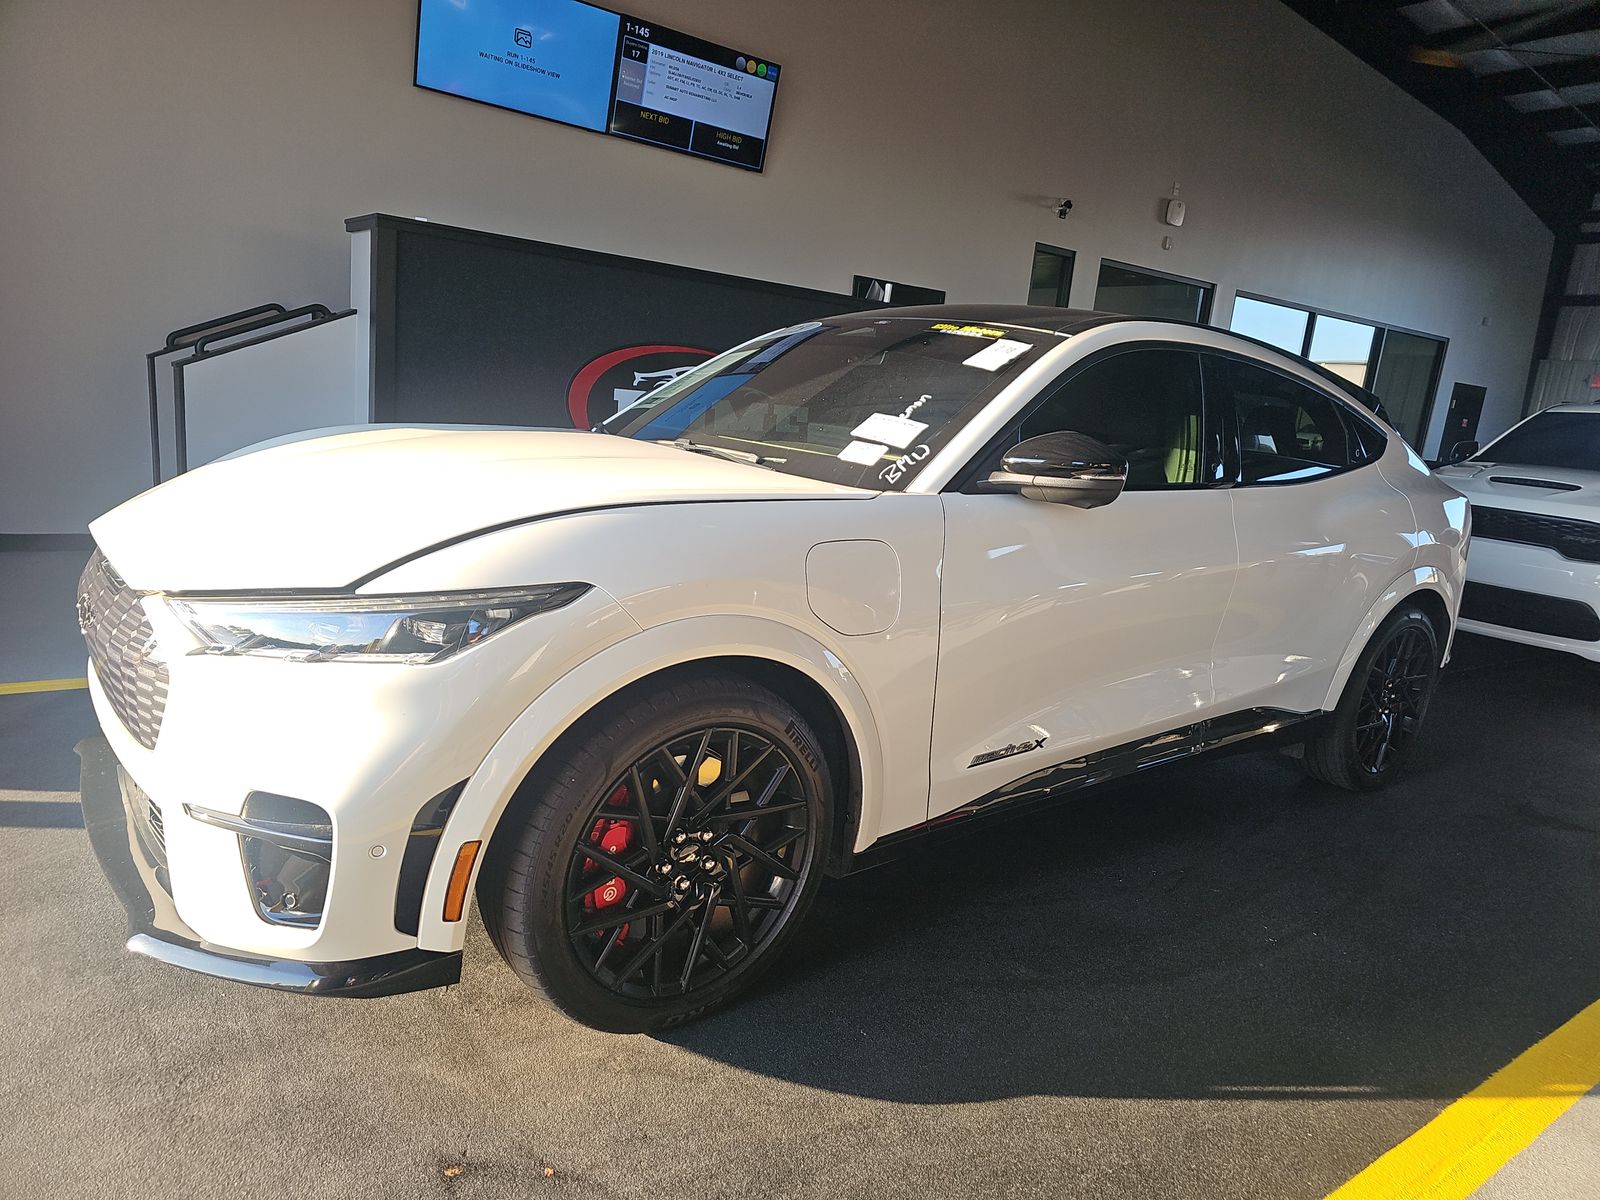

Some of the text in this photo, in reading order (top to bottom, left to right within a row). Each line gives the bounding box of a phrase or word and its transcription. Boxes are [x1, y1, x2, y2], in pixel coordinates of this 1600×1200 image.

[626, 22, 650, 38] 1-145
[506, 50, 536, 64] RUN 1-145
[631, 49, 641, 58] 17
[478, 51, 561, 79] WAITING ON SLIDESHOW VIEW
[651, 48, 664, 58] 2019
[664, 52, 686, 64] LINCOLN
[686, 59, 714, 72] NAVIGATOR
[717, 69, 727, 77] 4X2
[727, 72, 744, 82] SELECT
[640, 110, 670, 125] NEXT BID
[715, 130, 743, 144] HIGH BID
[784, 718, 819, 773] PIRELLI
